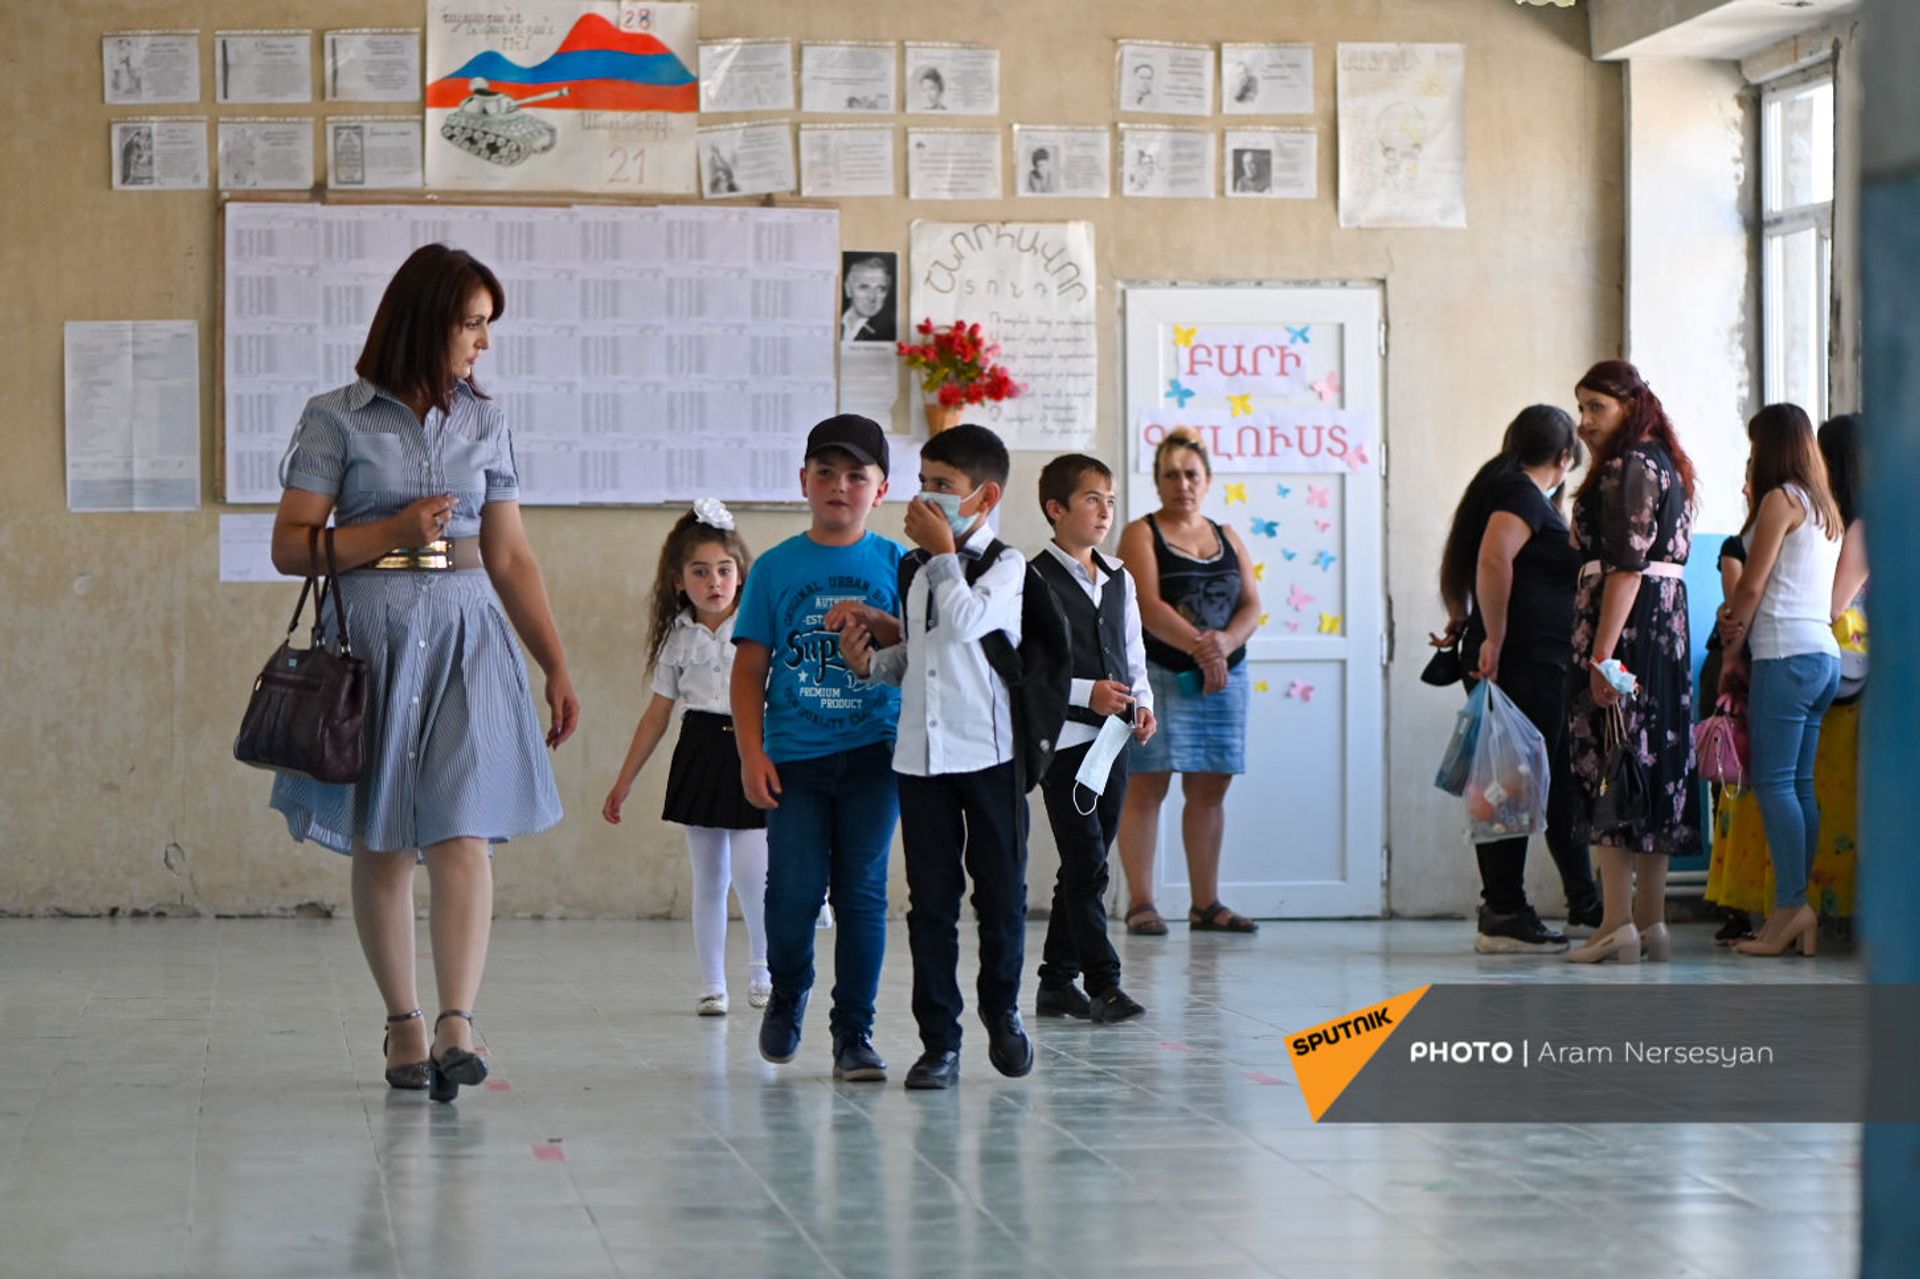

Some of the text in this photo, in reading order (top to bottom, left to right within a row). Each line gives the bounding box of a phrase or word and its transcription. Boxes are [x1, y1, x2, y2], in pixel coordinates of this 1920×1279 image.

[623, 8, 652, 30] 28
[608, 147, 645, 184] 21
[1185, 343, 1302, 377] ԲԱՐԻ
[1143, 424, 1350, 461] ԼՈՒՍՏ
[799, 687, 841, 698] PREMIUM
[820, 698, 863, 709] PRODUCT
